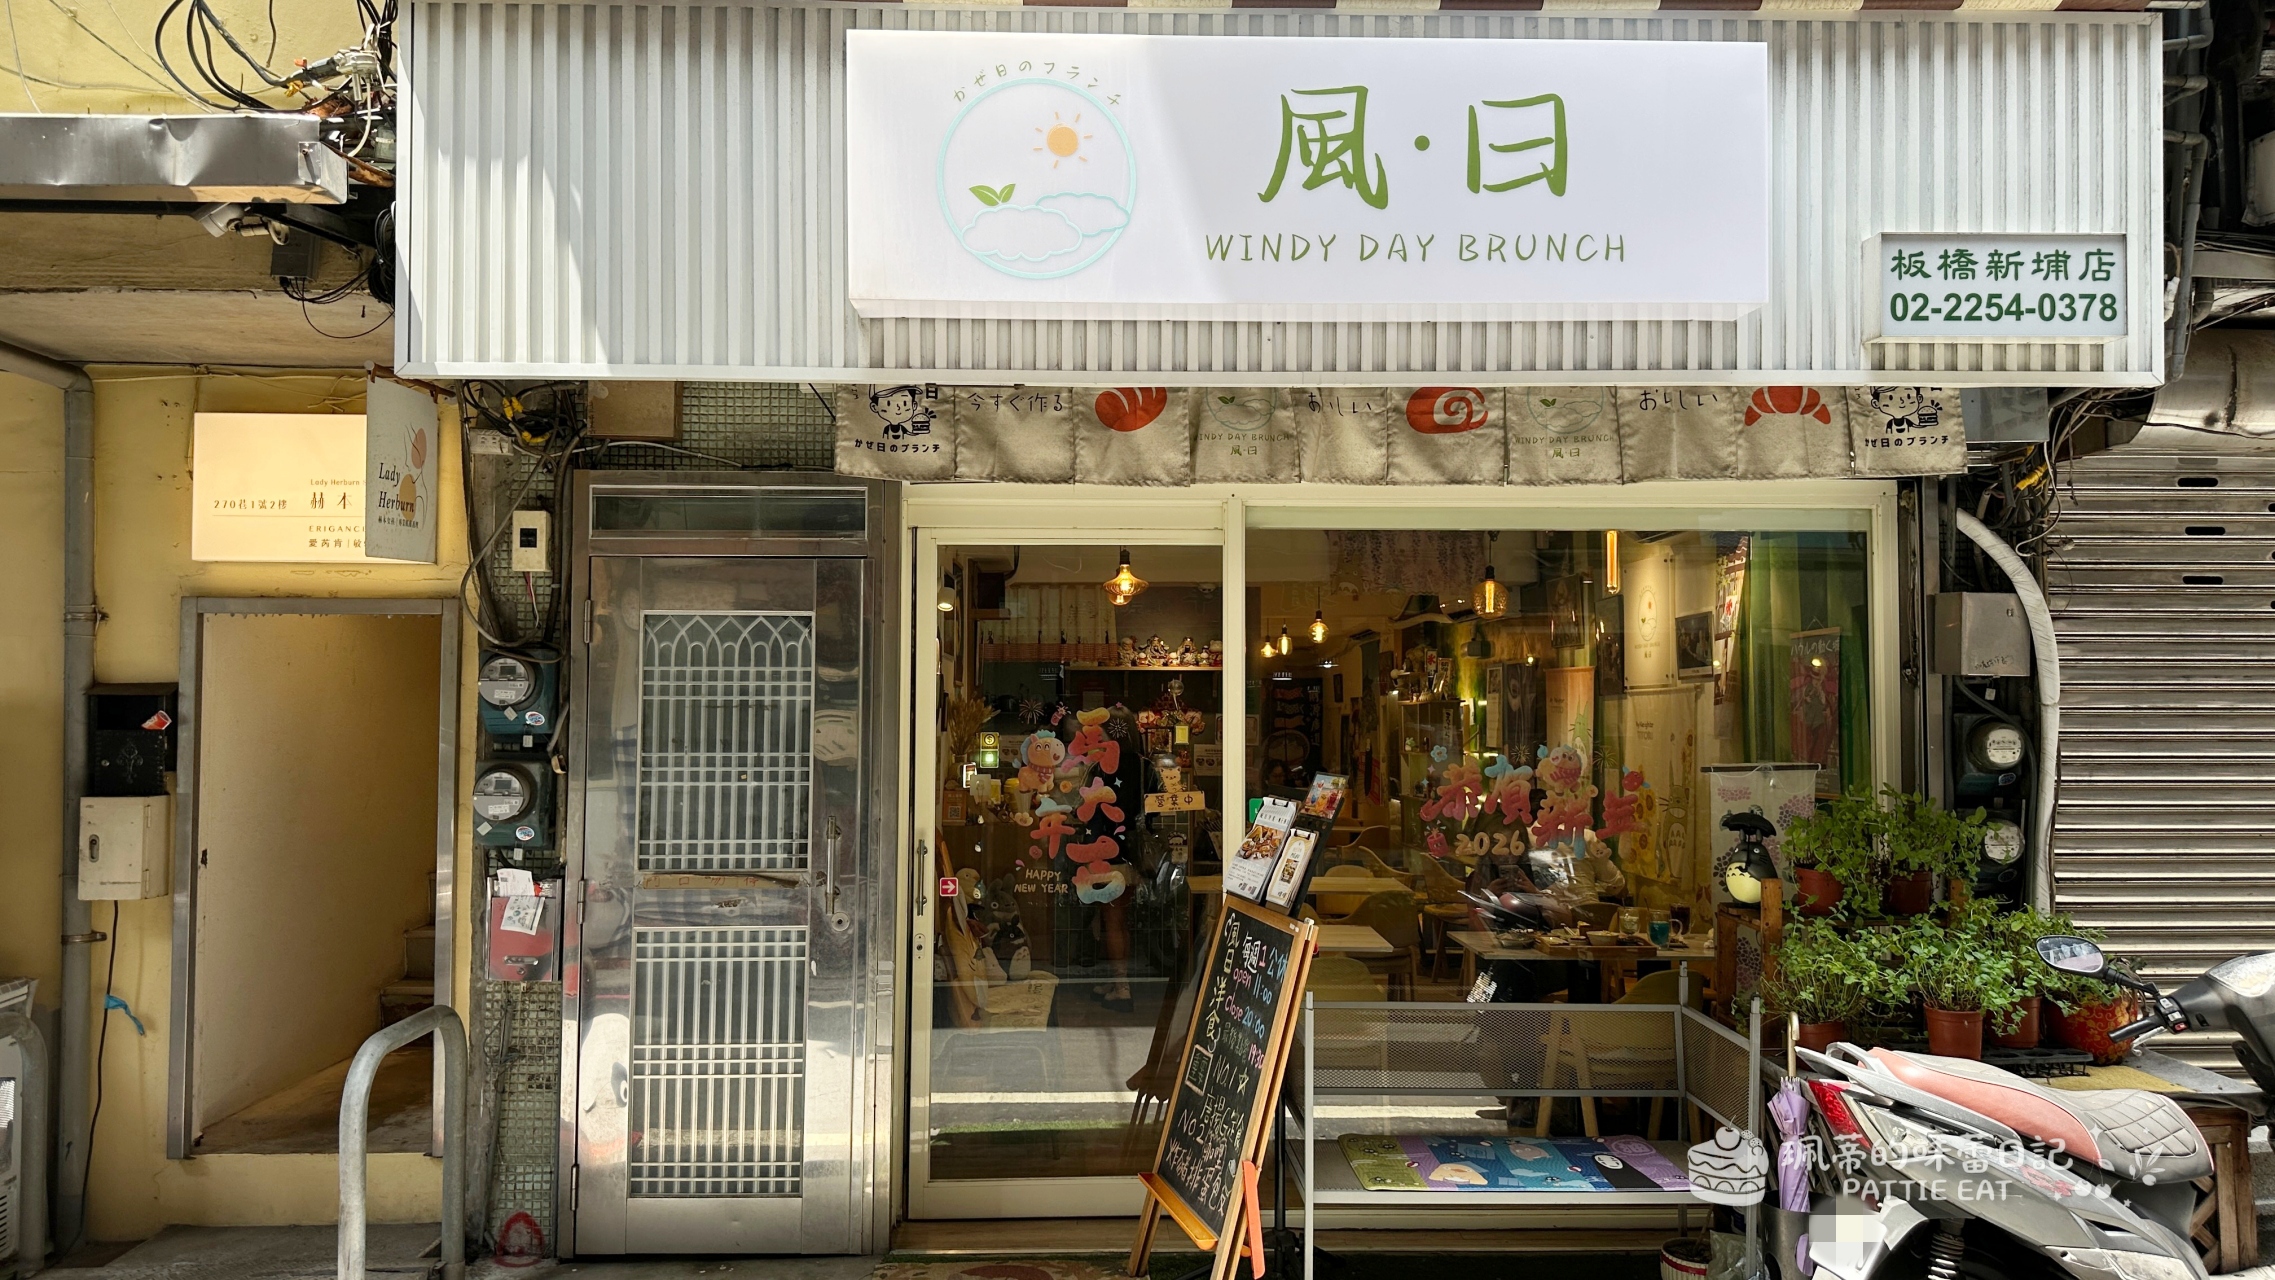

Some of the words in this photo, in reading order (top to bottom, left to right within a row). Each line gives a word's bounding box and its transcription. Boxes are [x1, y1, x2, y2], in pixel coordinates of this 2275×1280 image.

[1206, 234, 1336, 262] WINDY
[1360, 234, 1434, 262] DAY
[1459, 234, 1625, 262] BRUNCH
[1890, 248, 2116, 282] 板橋新埔店
[1890, 292, 2117, 322] 02-2254-0378
[967, 392, 1063, 412] 今すぐ作る
[1639, 389, 1718, 411] おいしい
[854, 438, 940, 453] かぜ日のブランチ
[1198, 432, 1224, 441] INDY
[1227, 432, 1247, 441] DAY
[1251, 432, 1290, 442] BRUNCH
[1514, 436, 1545, 445] WINDY
[1549, 435, 1569, 444] DAY
[310, 478, 328, 487] Lady
[330, 478, 360, 486] Herburn
[379, 462, 401, 487] Lady
[378, 491, 414, 513] Herburn
[1455, 830, 1525, 856] 2026
[1025, 868, 1061, 881] HAPPY
[1014, 883, 1037, 893] NEW
[1041, 883, 1069, 893] YEAR
[1253, 973, 1272, 1004] 11:00
[1242, 1006, 1265, 1039] 20:00
